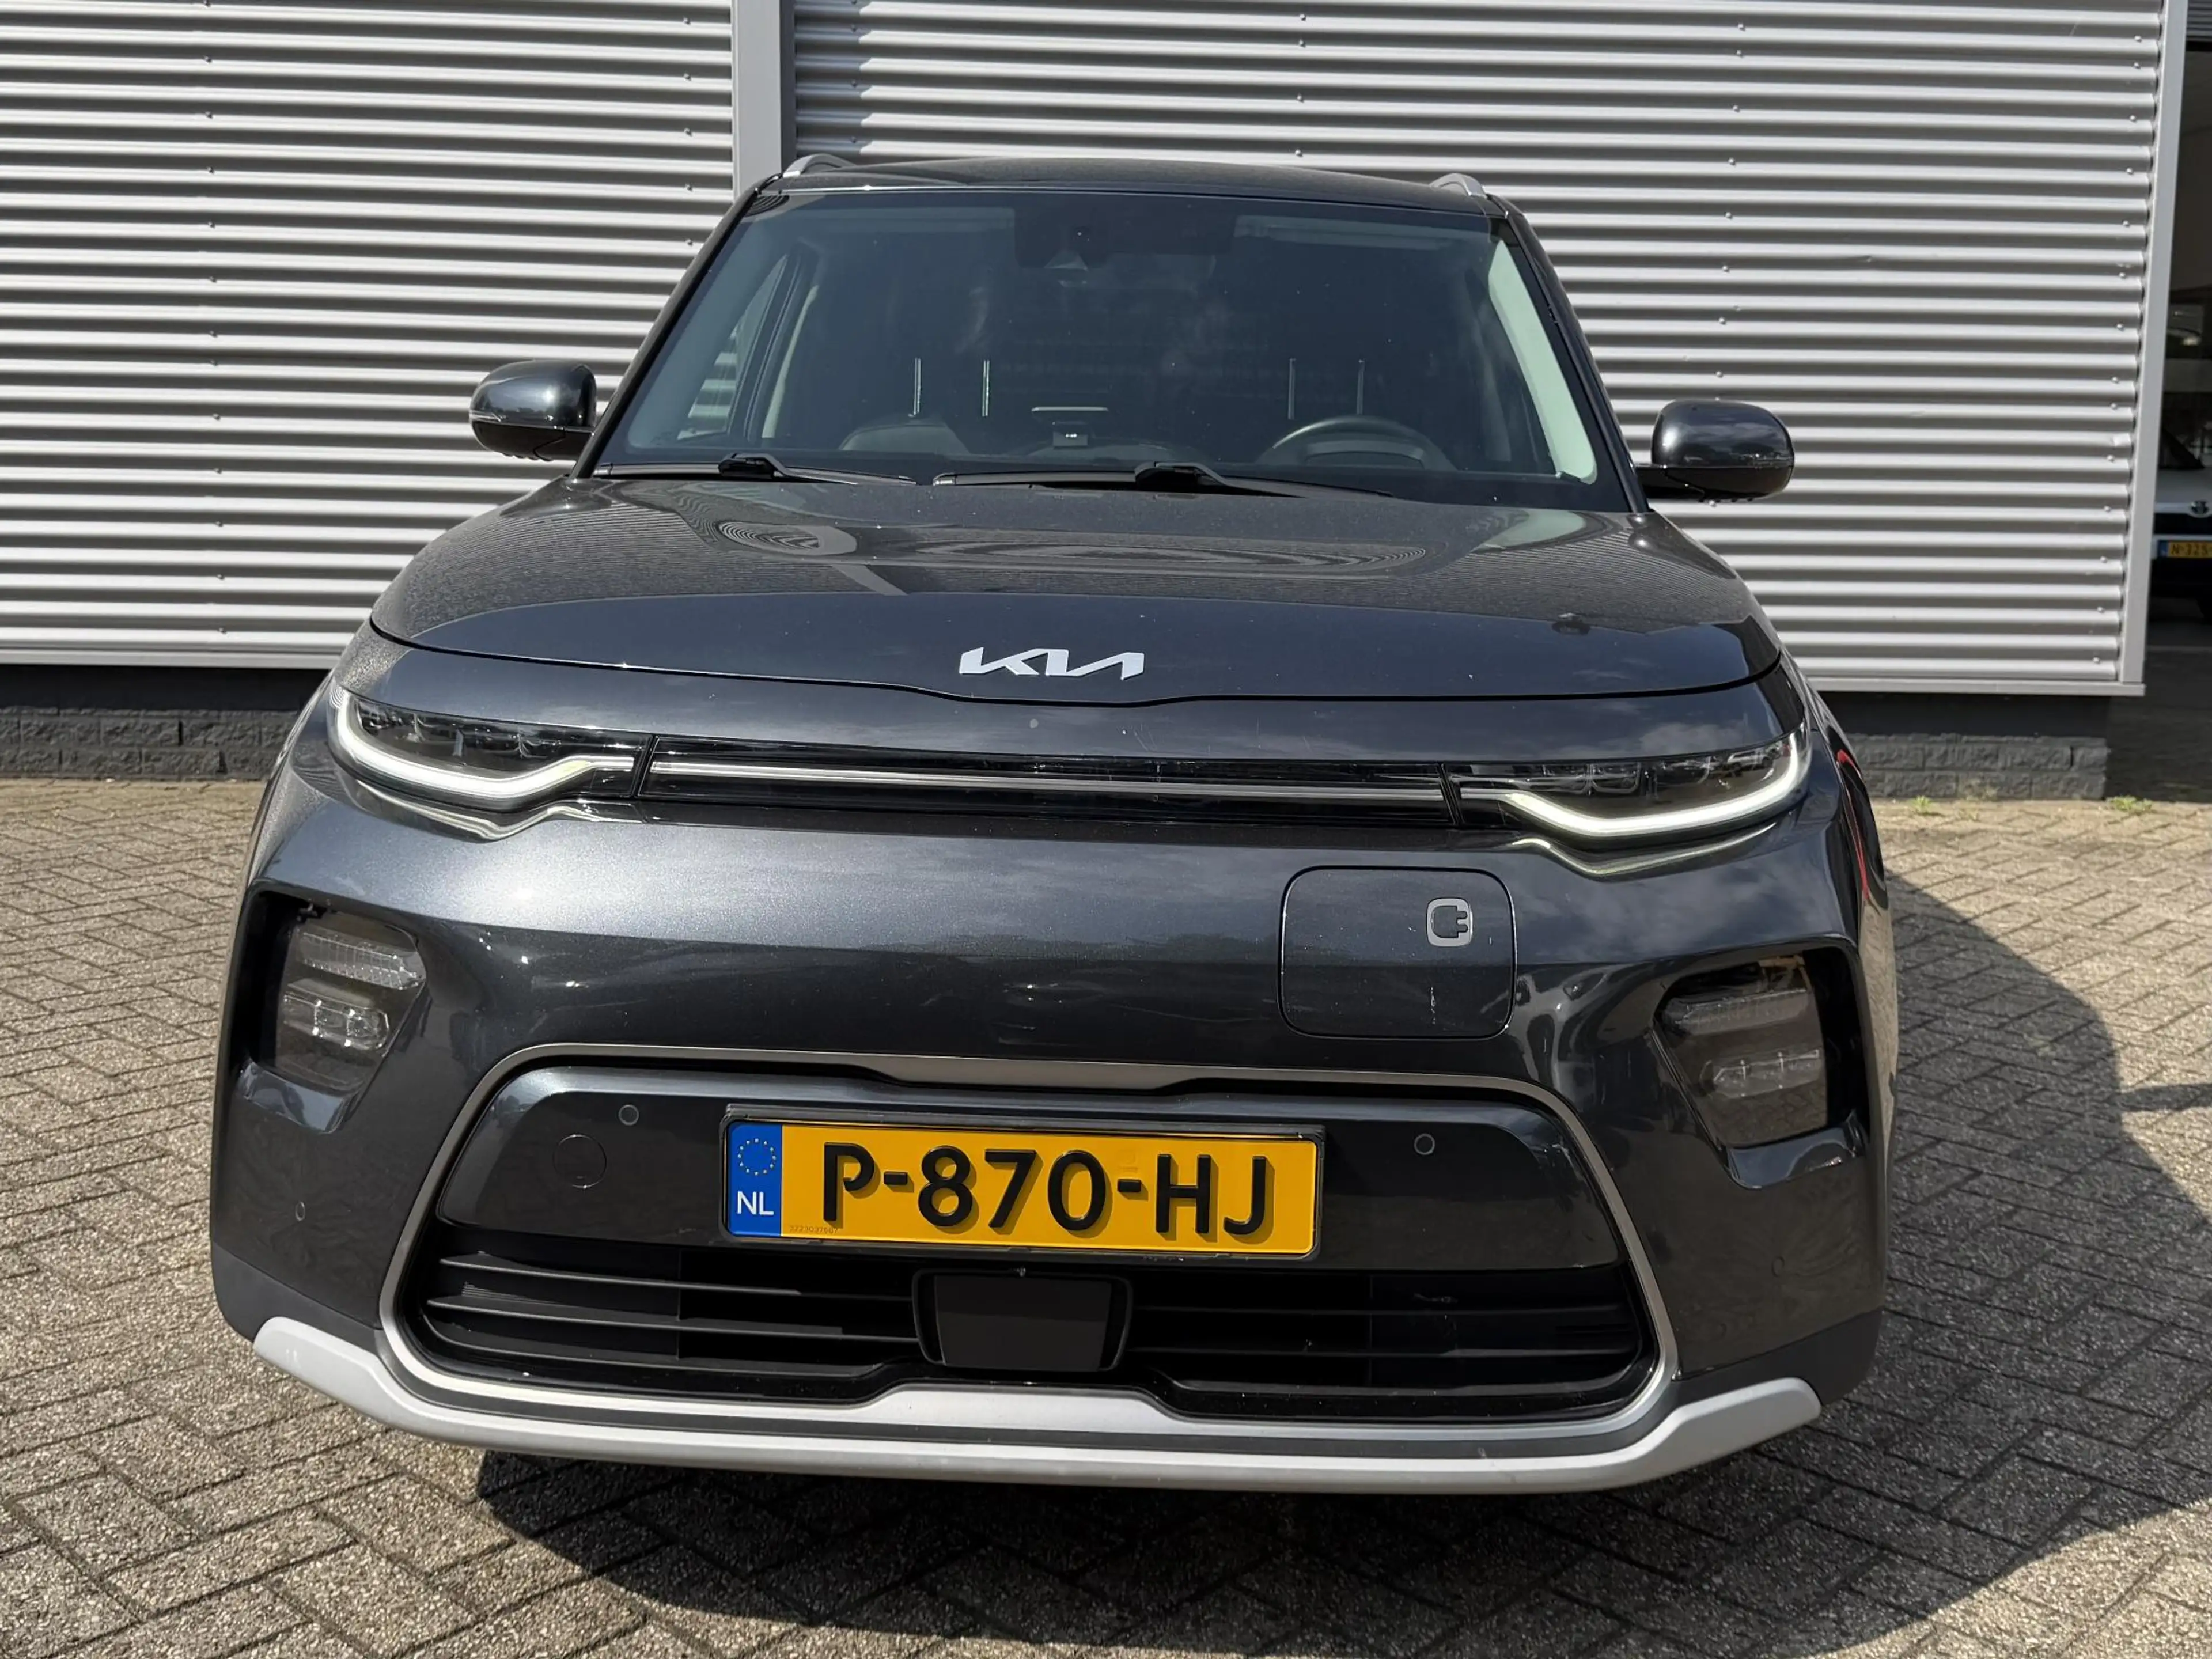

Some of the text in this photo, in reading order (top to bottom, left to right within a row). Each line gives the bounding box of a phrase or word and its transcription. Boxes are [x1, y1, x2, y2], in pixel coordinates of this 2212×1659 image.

[959, 646, 1145, 680] KIA
[737, 1190, 774, 1216] NL
[822, 1141, 1268, 1237] P-870-HJ
